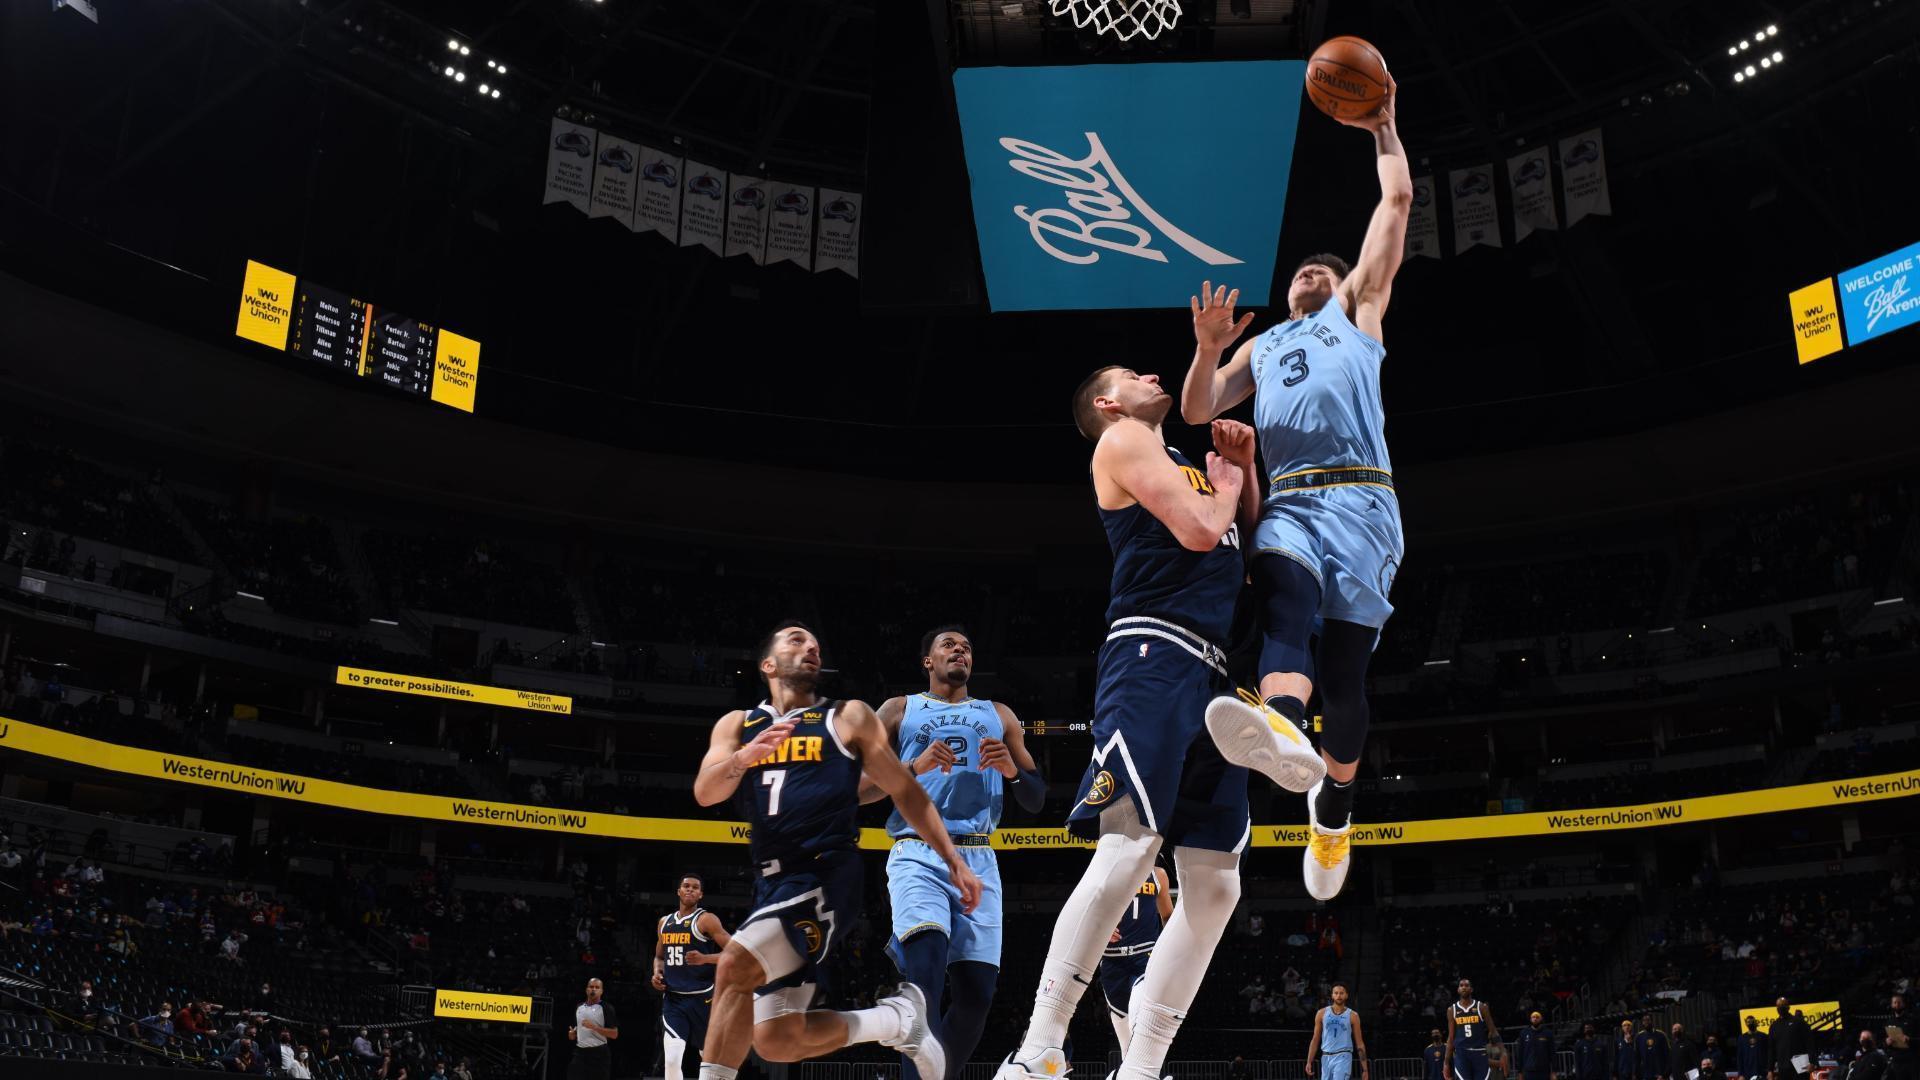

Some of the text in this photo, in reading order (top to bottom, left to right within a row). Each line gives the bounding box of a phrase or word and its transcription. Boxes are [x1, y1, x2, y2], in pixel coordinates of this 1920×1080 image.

[1313, 67, 1368, 97] SPALDING
[999, 132, 1246, 265] Ball
[1845, 258, 1913, 293] WELCOME
[258, 288, 278, 302] WU
[1864, 275, 1910, 333] Ball
[245, 294, 289, 317] Western
[250, 306, 280, 324] Union
[1806, 305, 1823, 318] WU
[1796, 311, 1836, 332] Western
[1804, 324, 1831, 339] Union
[437, 361, 475, 382] Western
[449, 355, 466, 368] WU
[1279, 348, 1310, 388] 3
[443, 372, 469, 389] Union
[348, 672, 475, 698] to greater possibilities.
[517, 691, 552, 702] Western
[527, 700, 568, 713] Union WU
[905, 714, 988, 745] GRIZZLIE
[1069, 723, 1087, 731] ORB
[163, 758, 306, 795] WesternUnion WU
[762, 769, 787, 816] 7
[453, 802, 587, 828] WesternUnion WU
[1548, 805, 1683, 828] WesternUnion WU
[1273, 828, 1403, 842] Westion WU
[662, 932, 691, 945] DENVER
[666, 946, 684, 966] 35
[439, 998, 528, 1015] WesternUnion WU
[1455, 1015, 1479, 1025] DENVER
[1464, 1024, 1472, 1038] 5
